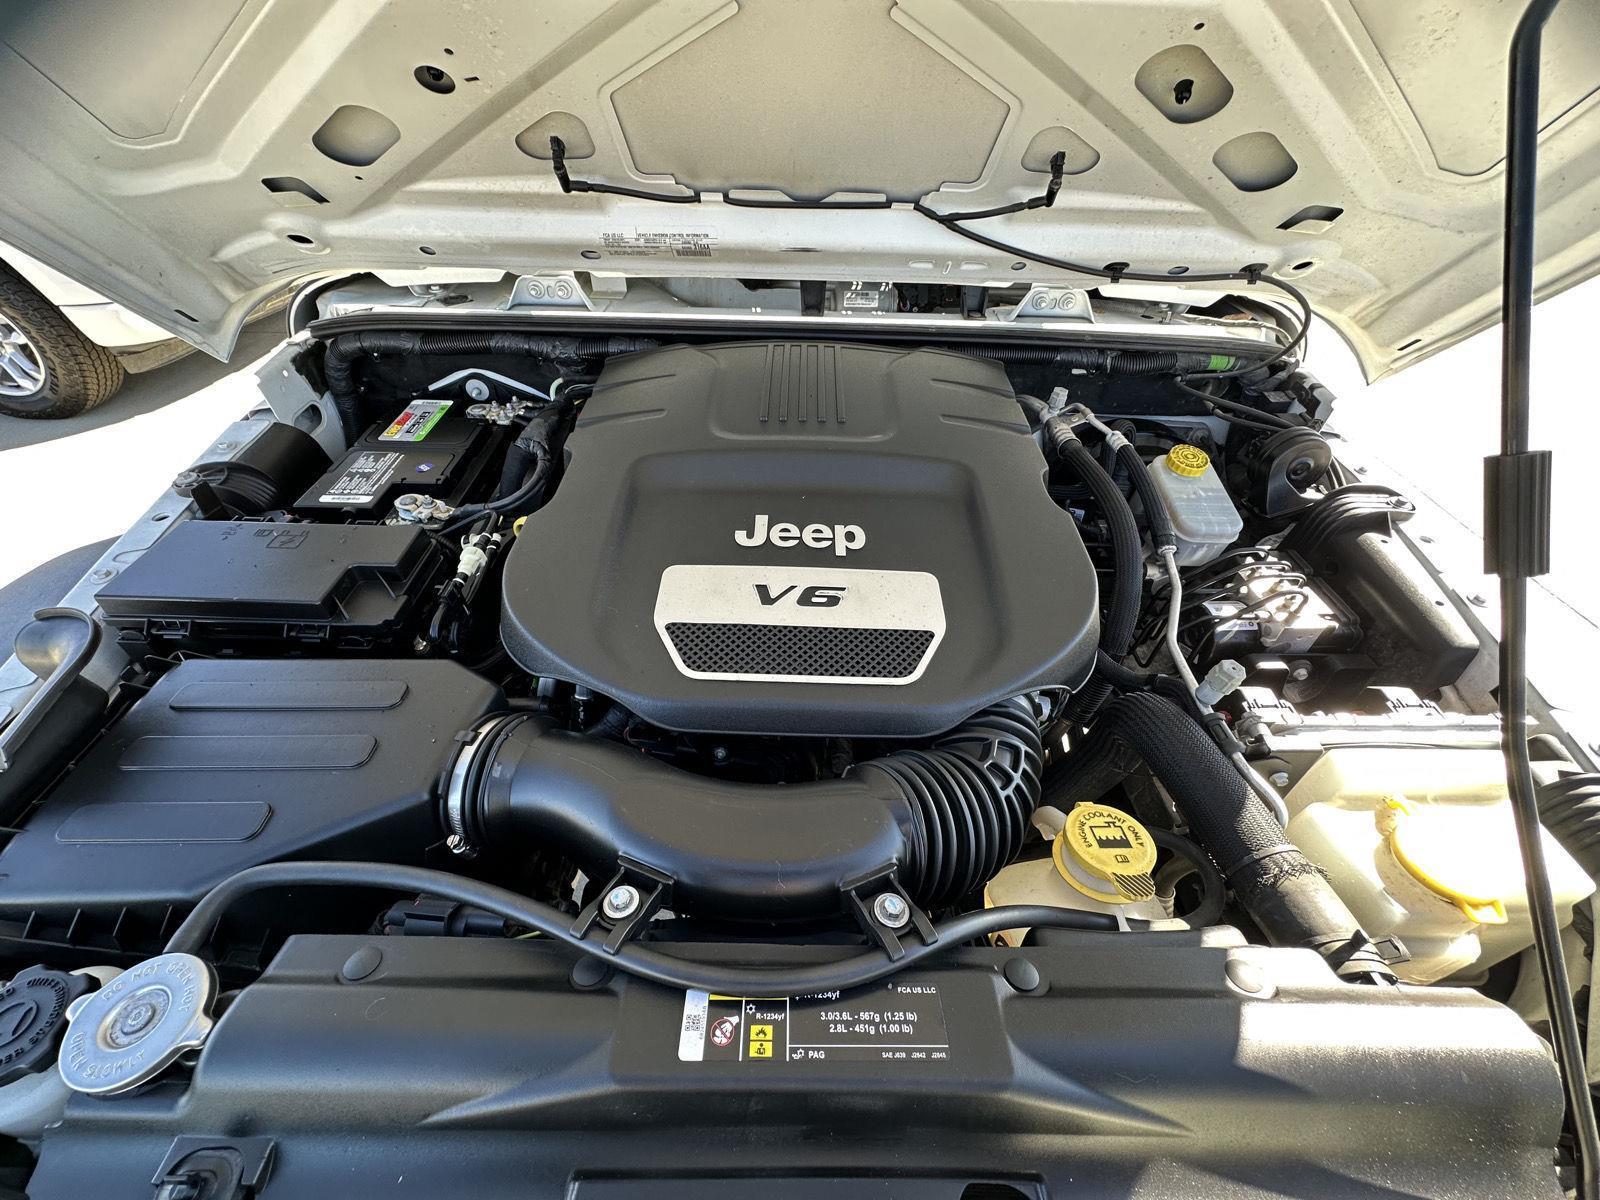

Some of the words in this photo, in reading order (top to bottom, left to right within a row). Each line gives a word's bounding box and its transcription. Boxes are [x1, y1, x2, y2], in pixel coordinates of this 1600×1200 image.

[734, 514, 867, 557] Jeep
[753, 584, 848, 608] V6
[1083, 810, 1127, 825] COOLANT
[1077, 819, 1093, 848] ENGINE
[1127, 825, 1145, 848] ONLY
[131, 962, 163, 982] NOT
[166, 961, 194, 988] OPEN
[102, 981, 124, 1001] DO
[178, 984, 198, 1012] HOT
[897, 986, 911, 994] FCA
[912, 986, 922, 994] US
[922, 986, 937, 994] LLC
[755, 1012, 785, 1022] R-1234yf
[820, 1011, 853, 1021] 3.0/3.6L
[859, 1011, 881, 1023] 567g
[884, 1011, 905, 1023] (1.25
[905, 1011, 918, 1023] lb)
[829, 1024, 848, 1033] 2.8L
[854, 1023, 875, 1035] 451g
[879, 1023, 900, 1035] (1.00
[901, 1023, 914, 1035] lb)
[70, 1031, 88, 1071] OPEN
[81, 1049, 145, 1080] SLOWLY
[808, 1050, 825, 1059] PAG
[881, 1051, 893, 1059] SAE
